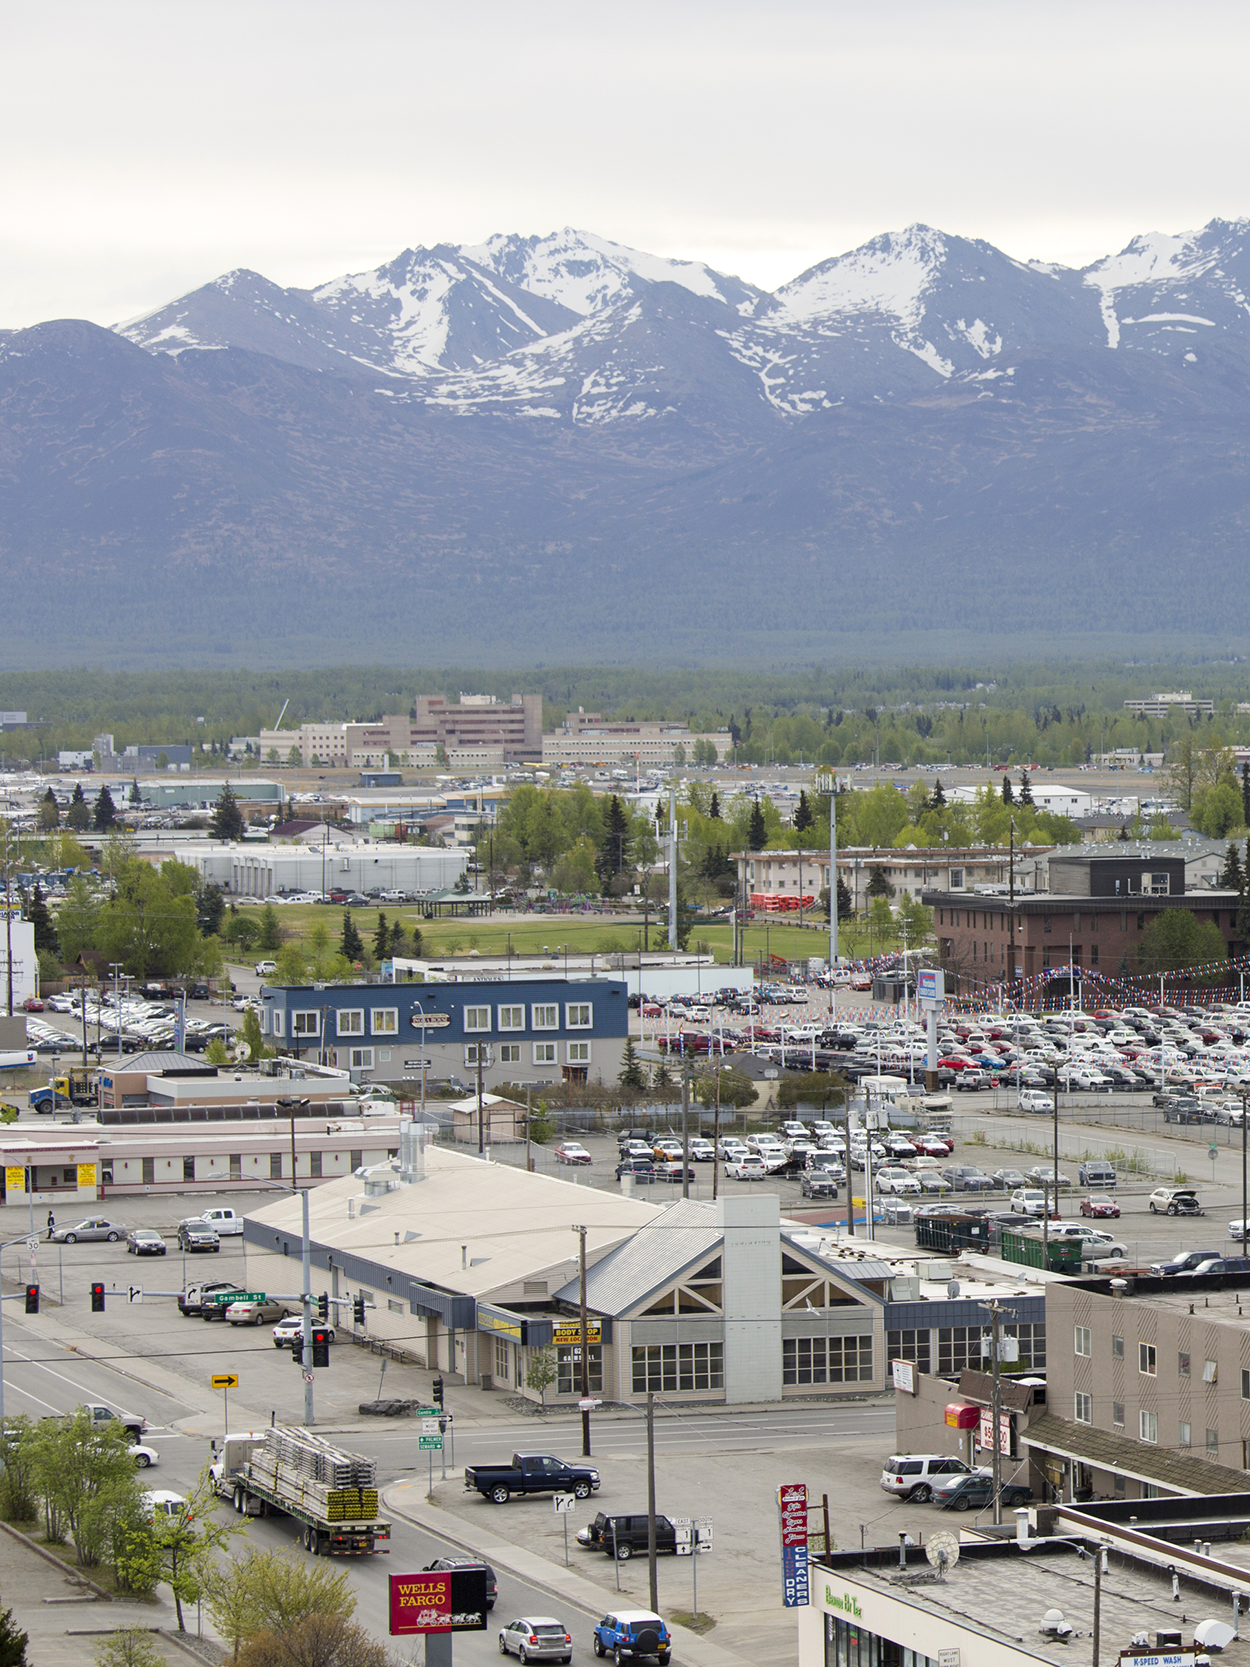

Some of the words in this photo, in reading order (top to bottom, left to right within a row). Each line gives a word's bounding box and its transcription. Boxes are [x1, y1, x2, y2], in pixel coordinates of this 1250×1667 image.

[28, 1242, 39, 1250] 30
[559, 1320, 595, 1328] KENDLL
[556, 1328, 576, 1336] BODY
[685, 1530, 689, 1539] 1
[708, 1528, 711, 1537] 1
[786, 1548, 792, 1560] 1
[795, 1546, 808, 1606] CLEANERS
[398, 1583, 446, 1595] WELLS
[786, 1578, 796, 1606] DRY
[399, 1595, 446, 1607] FARGO
[1134, 1657, 1159, 1666] K-SPEED
[1163, 1656, 1183, 1664] WASH
